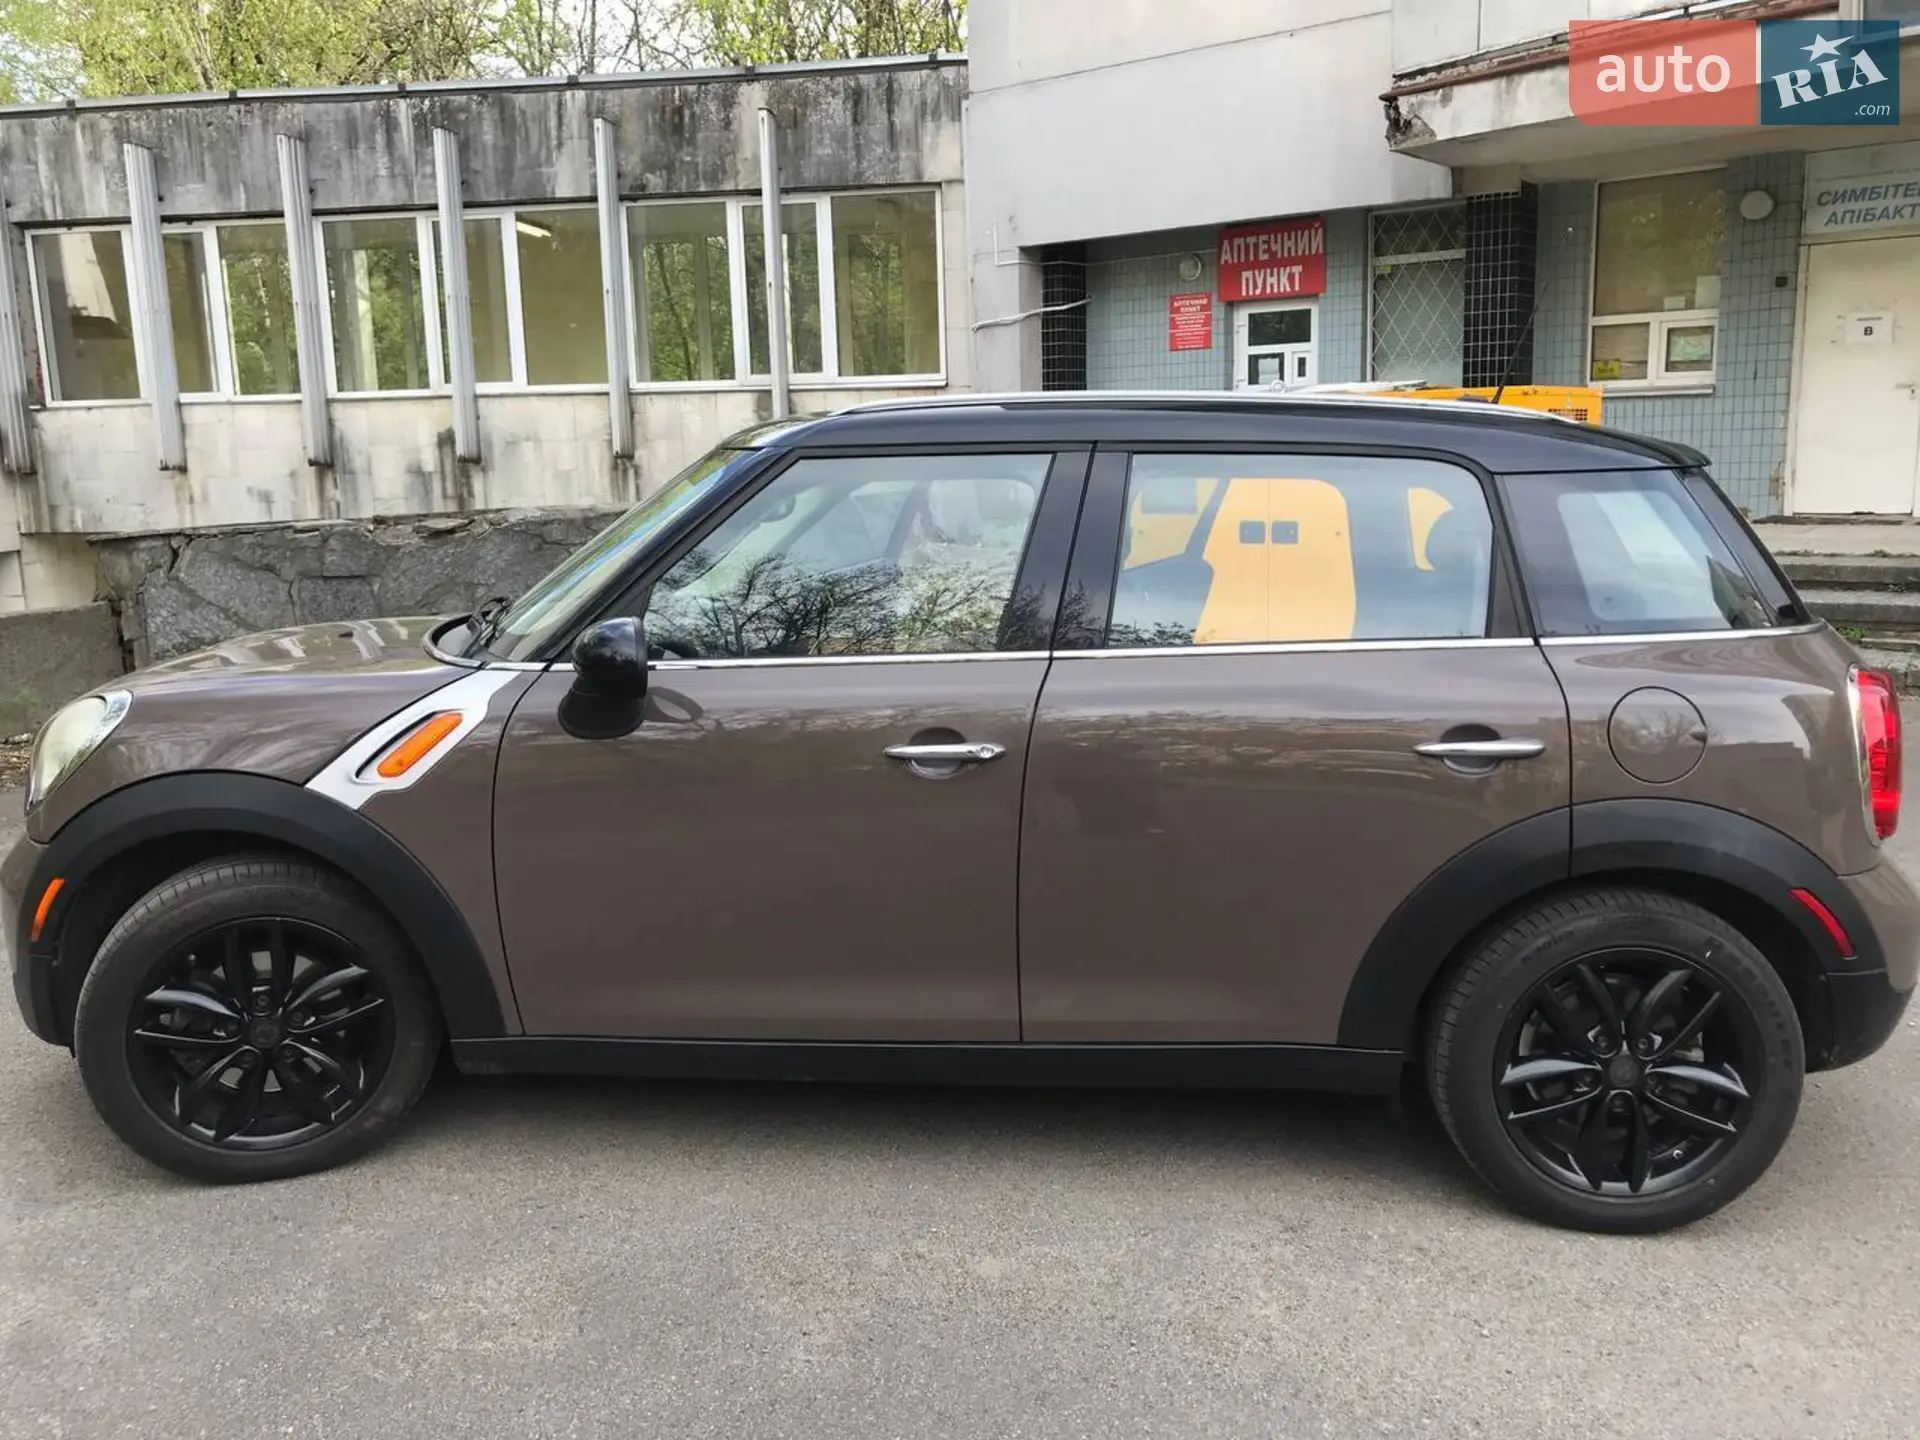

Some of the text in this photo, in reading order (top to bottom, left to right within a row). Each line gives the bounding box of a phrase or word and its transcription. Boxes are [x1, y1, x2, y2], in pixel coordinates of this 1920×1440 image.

[1816, 182, 1920, 207] СИМБІТЕ
[1220, 222, 1323, 264] АПТЕЧНИЙ
[1241, 265, 1303, 297] ПУНКТ
